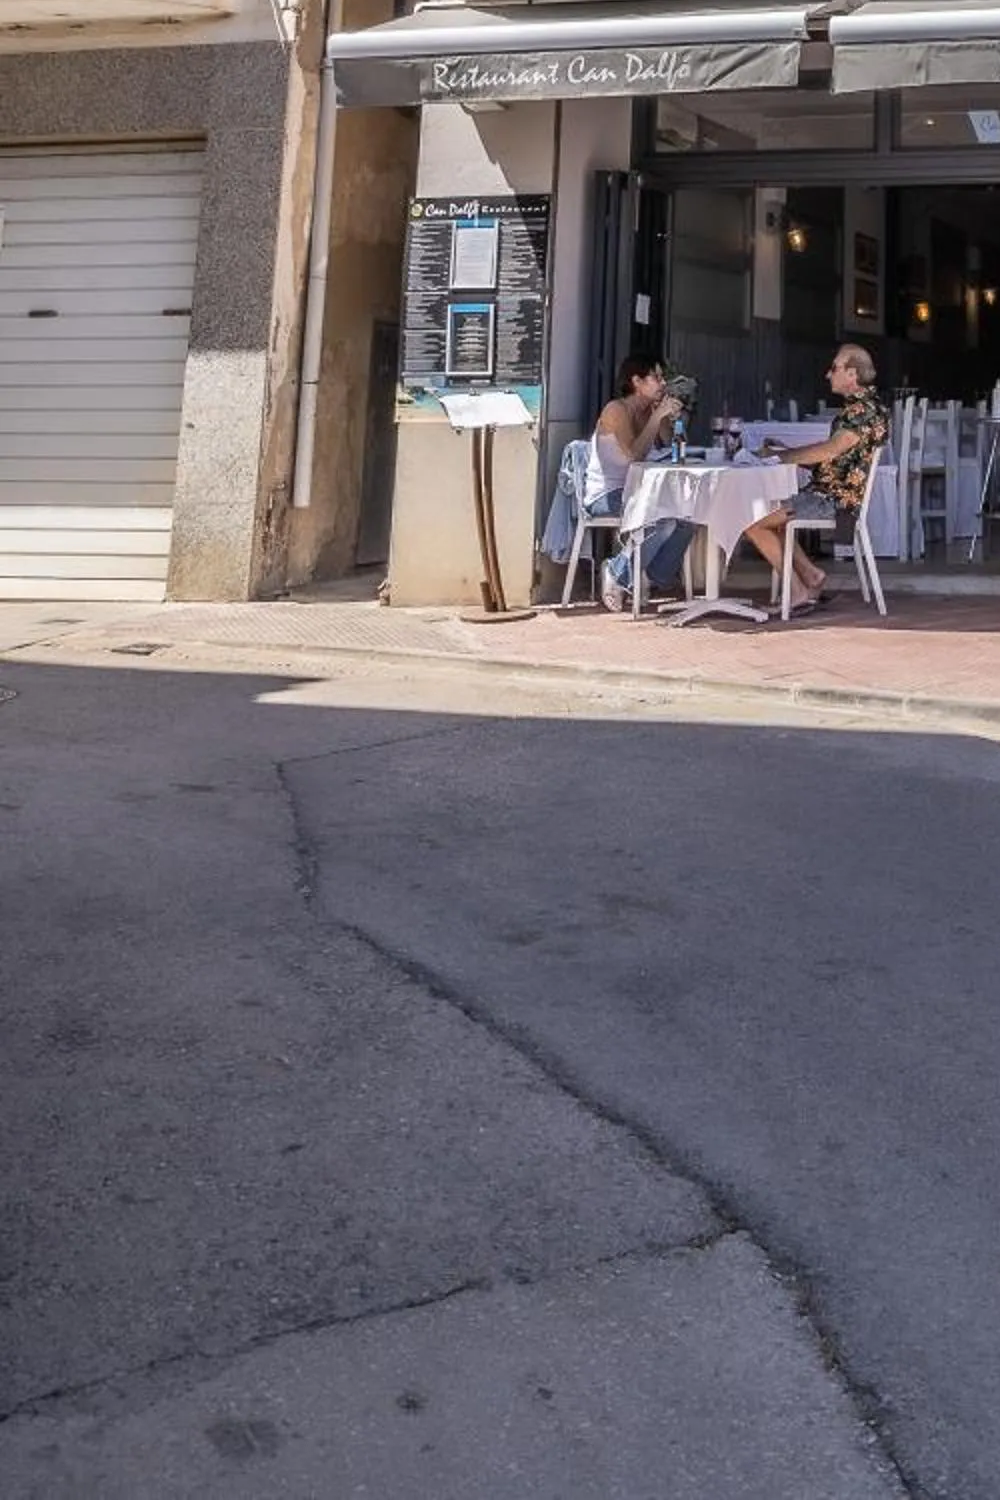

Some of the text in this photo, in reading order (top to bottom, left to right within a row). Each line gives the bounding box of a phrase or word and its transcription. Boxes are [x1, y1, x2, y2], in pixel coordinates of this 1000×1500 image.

[432, 51, 692, 90] Restaurant Can Dalfó
[424, 203, 448, 217] Can
